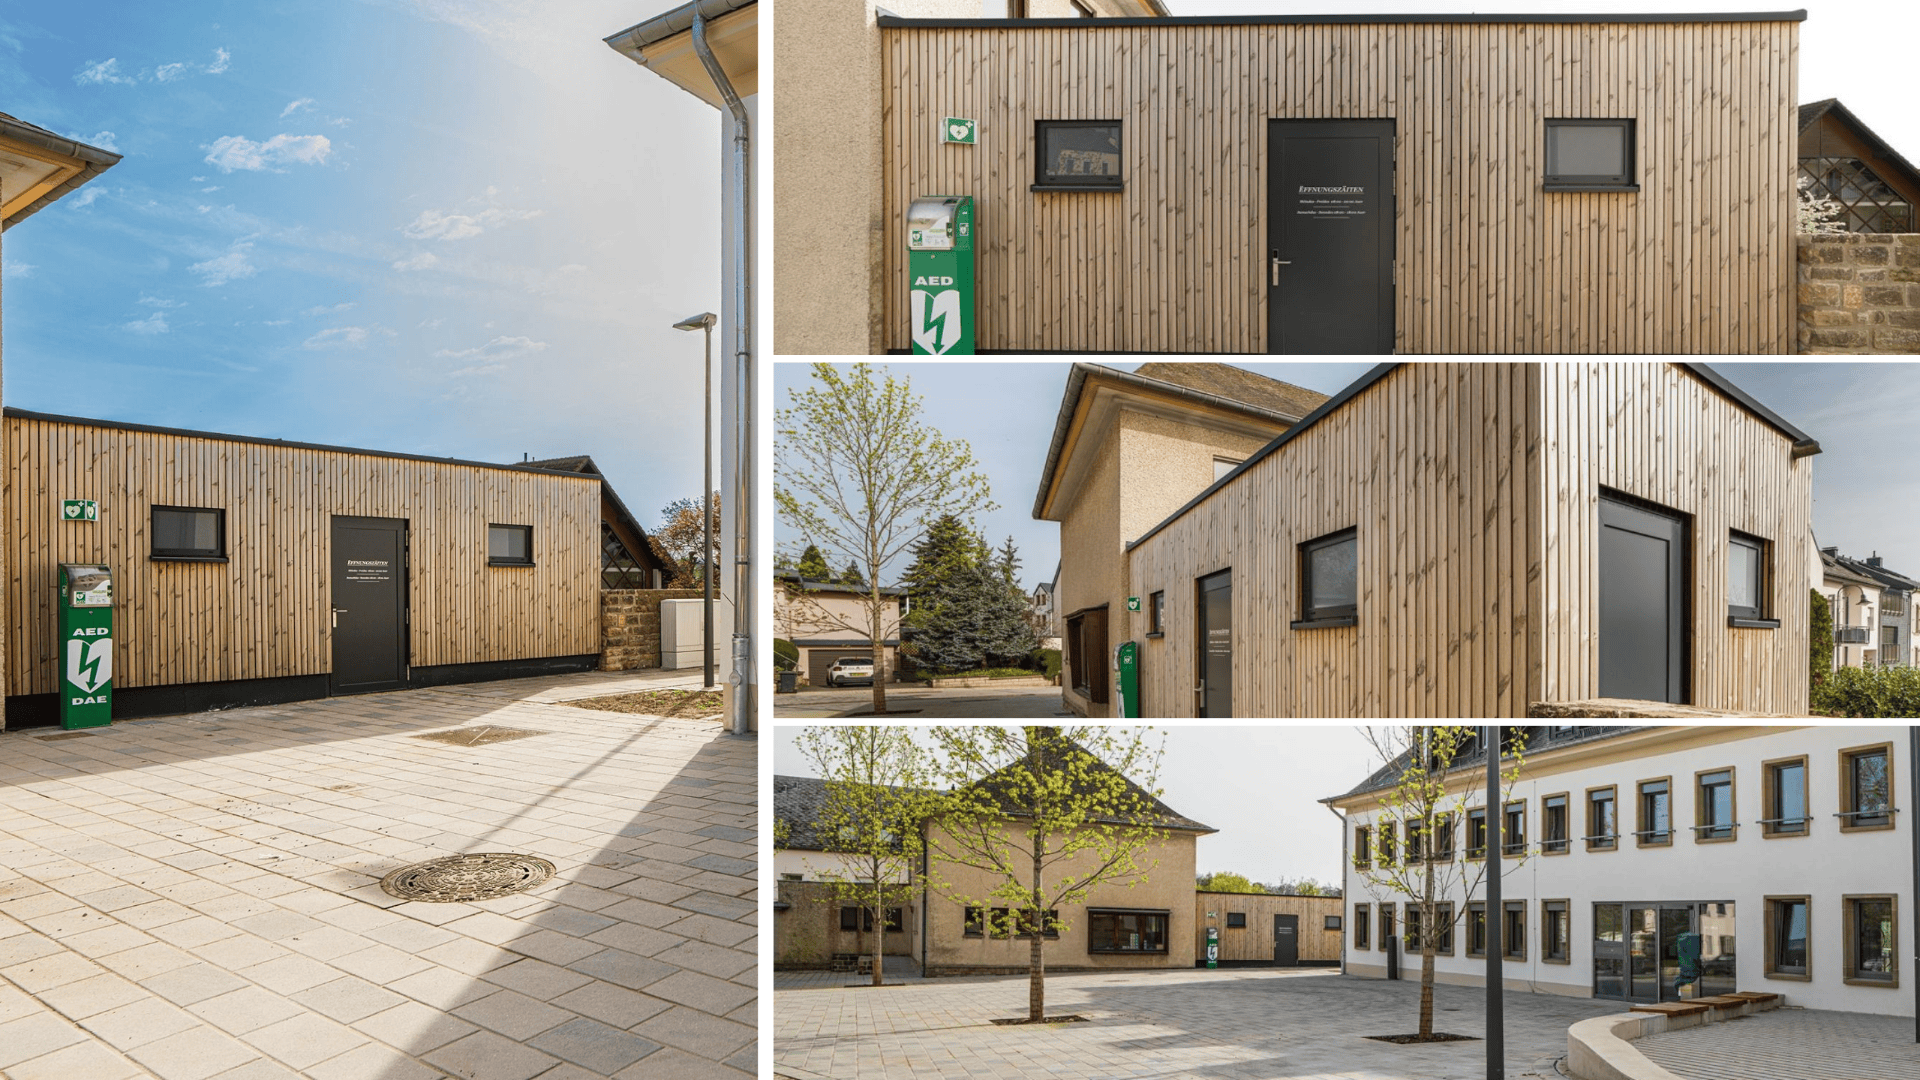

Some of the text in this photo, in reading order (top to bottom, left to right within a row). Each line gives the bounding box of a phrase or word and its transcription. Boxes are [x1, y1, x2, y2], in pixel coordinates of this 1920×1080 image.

[914, 275, 954, 286] AED
[72, 627, 109, 637] AED
[71, 695, 107, 705] DAE
